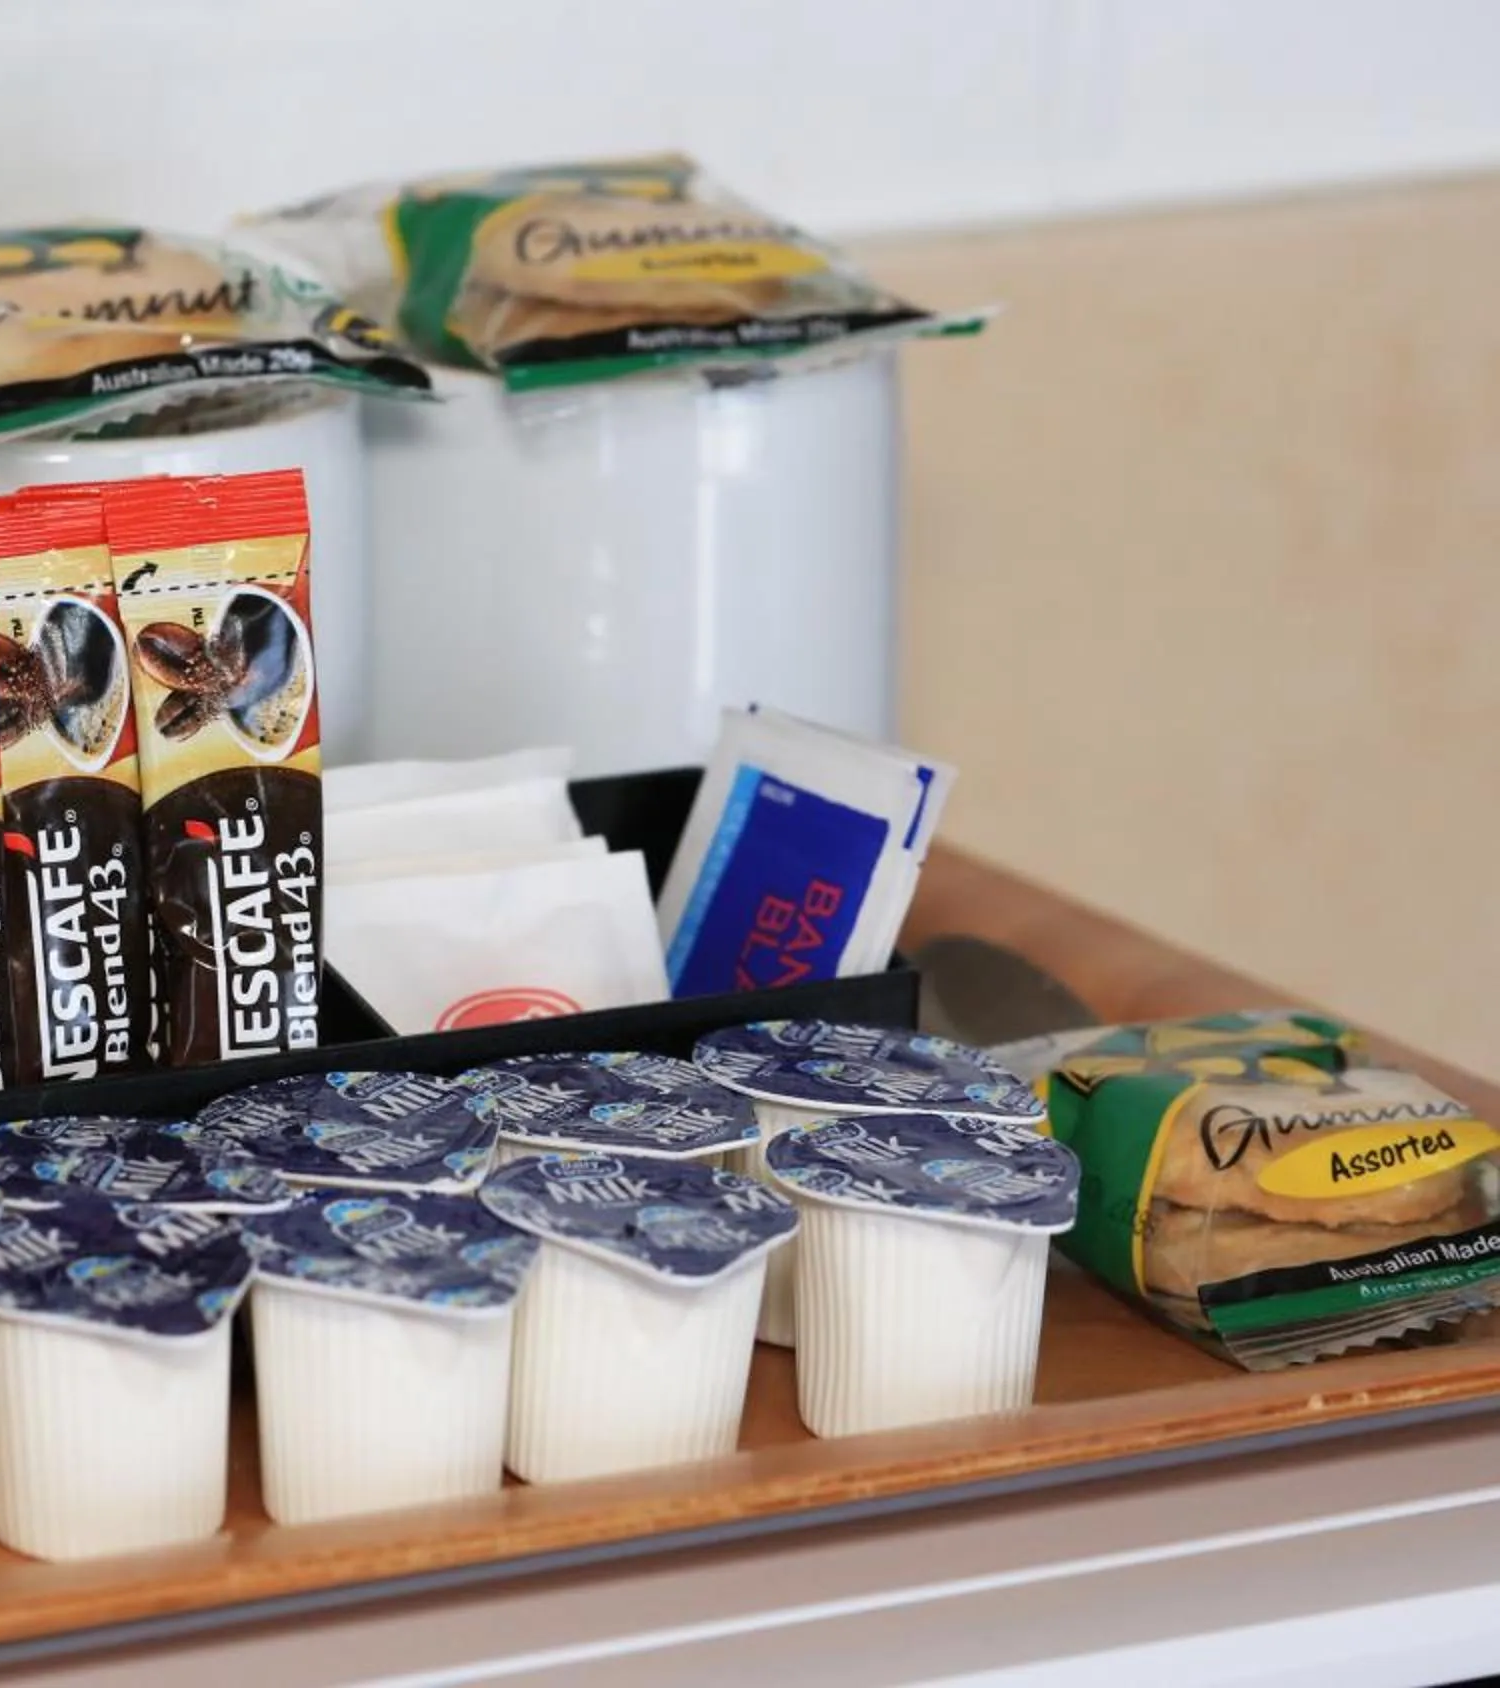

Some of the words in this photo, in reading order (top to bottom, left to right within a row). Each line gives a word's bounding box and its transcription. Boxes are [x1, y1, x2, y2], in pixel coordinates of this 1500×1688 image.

[91, 364, 197, 393] Australian
[338, 1133, 447, 1173] Milk
[1199, 1101, 1469, 1170] Gumnu
[1330, 1128, 1456, 1183] Assorted
[545, 1177, 664, 1204] Milk
[352, 1224, 467, 1262] Milk
[1328, 1246, 1439, 1282] Australian
[1440, 1234, 1500, 1261] Made
